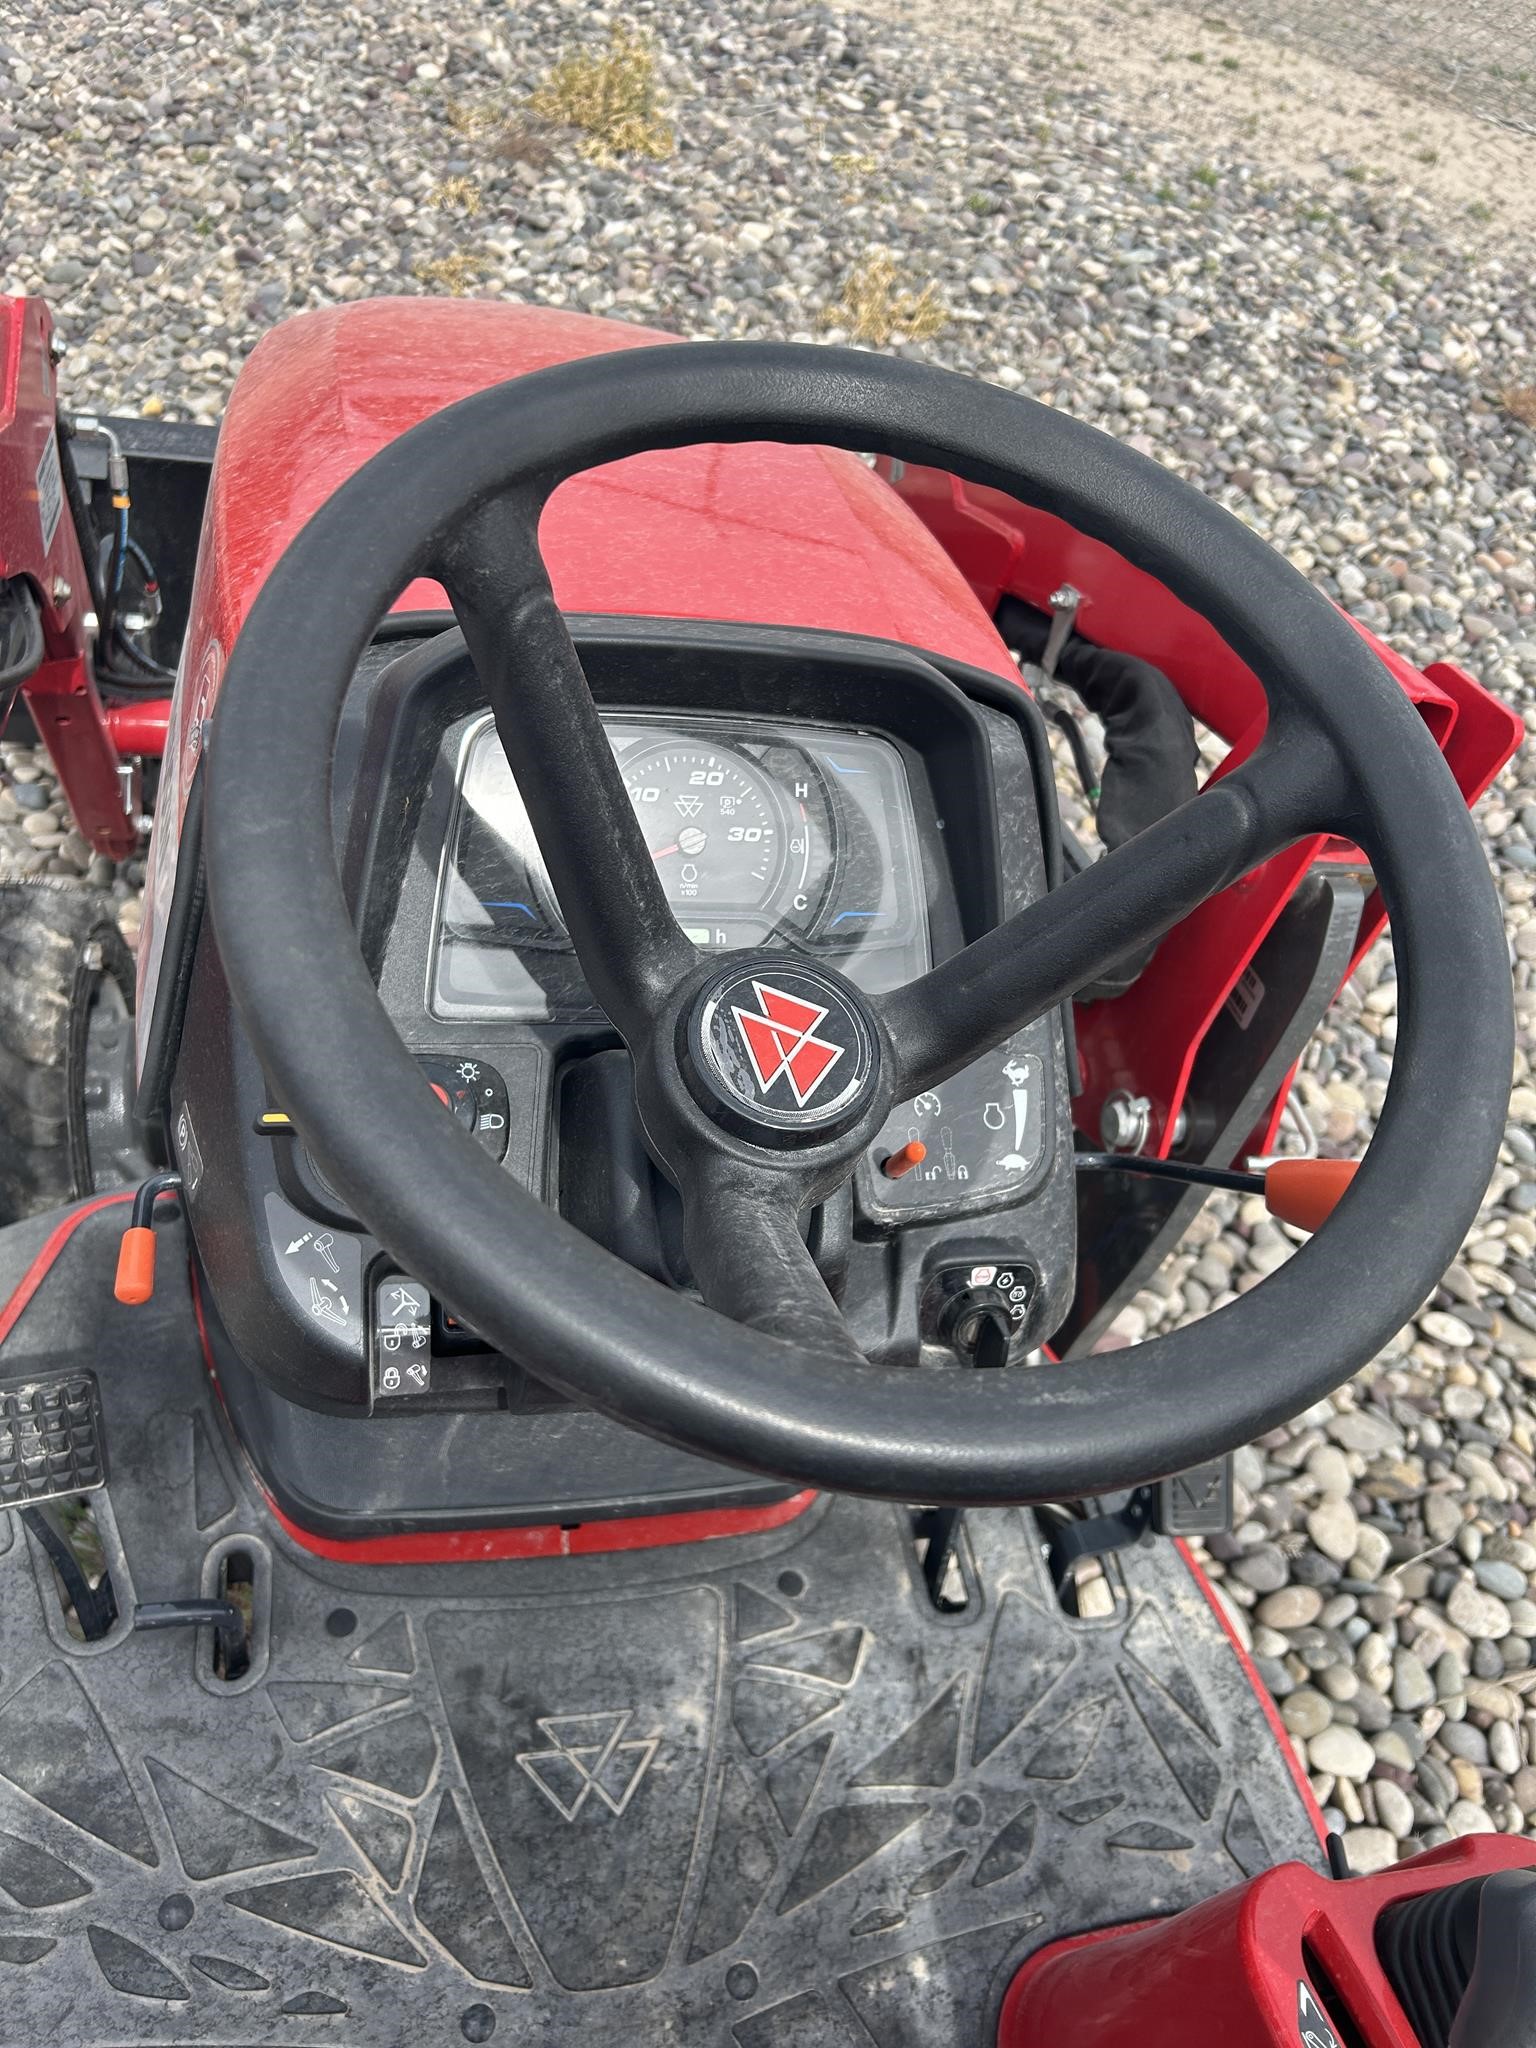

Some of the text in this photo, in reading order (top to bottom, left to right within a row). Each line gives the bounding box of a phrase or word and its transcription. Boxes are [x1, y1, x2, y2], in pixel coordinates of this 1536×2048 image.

[688, 771, 724, 786] 20
[630, 787, 661, 802] 10
[795, 783, 808, 798] H
[719, 808, 735, 816] 540
[727, 827, 762, 842] 30
[793, 894, 807, 911] C
[715, 928, 727, 944] h
